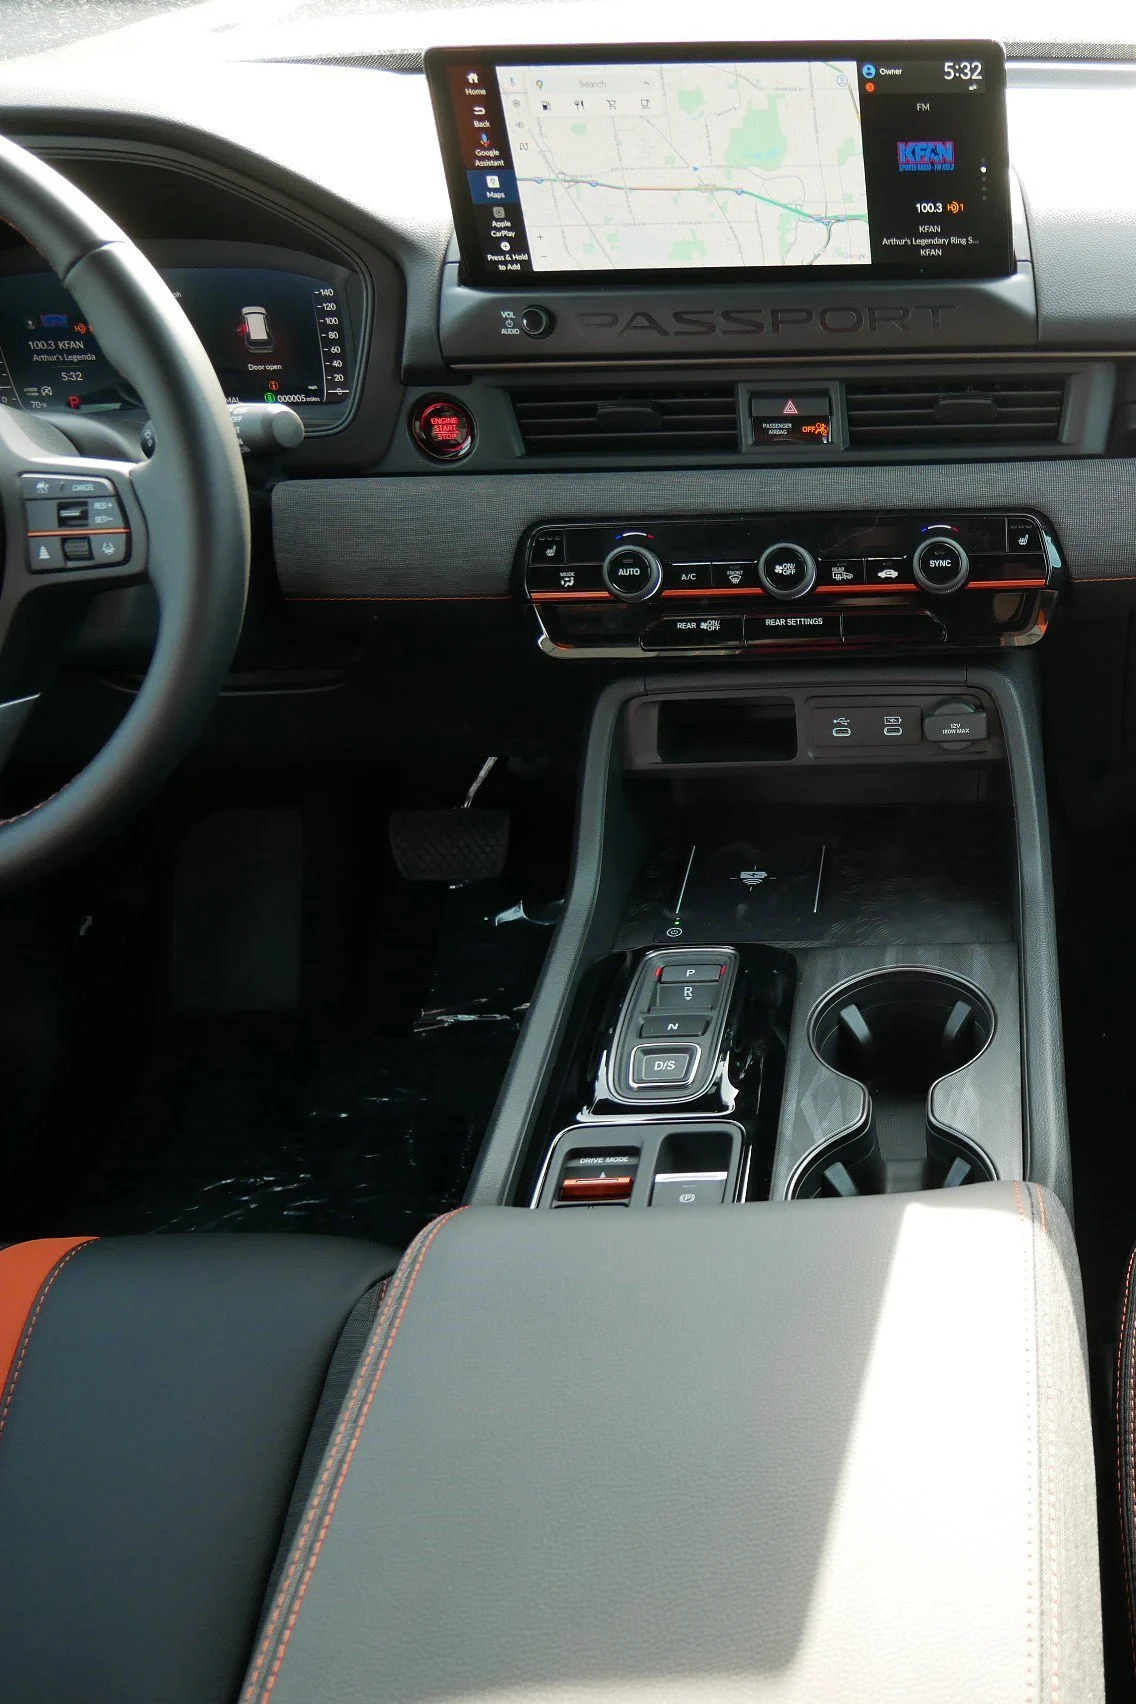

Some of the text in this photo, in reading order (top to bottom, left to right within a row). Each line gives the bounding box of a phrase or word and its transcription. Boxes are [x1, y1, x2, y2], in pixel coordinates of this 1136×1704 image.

[880, 68, 902, 76] Owner
[944, 62, 982, 80] 5:32
[578, 80, 606, 88] Search
[916, 103, 930, 112] FM
[898, 142, 954, 163] KFAN
[916, 203, 942, 213] 100.3
[912, 237, 948, 246] Legendary
[950, 237, 966, 245] Ring
[574, 304, 958, 338] PASSPORT
[28, 341, 84, 349] 100.3 KFAN
[65, 353, 96, 362] Legenda
[61, 372, 83, 381] 5:32
[69, 396, 80, 408] P
[929, 559, 951, 567] SYNC
[618, 568, 640, 576] AUTO
[681, 573, 696, 581] A/C
[787, 617, 823, 626] SETTINGS
[686, 969, 695, 977] P
[684, 987, 692, 997] R
[654, 1060, 676, 1071] D/S
